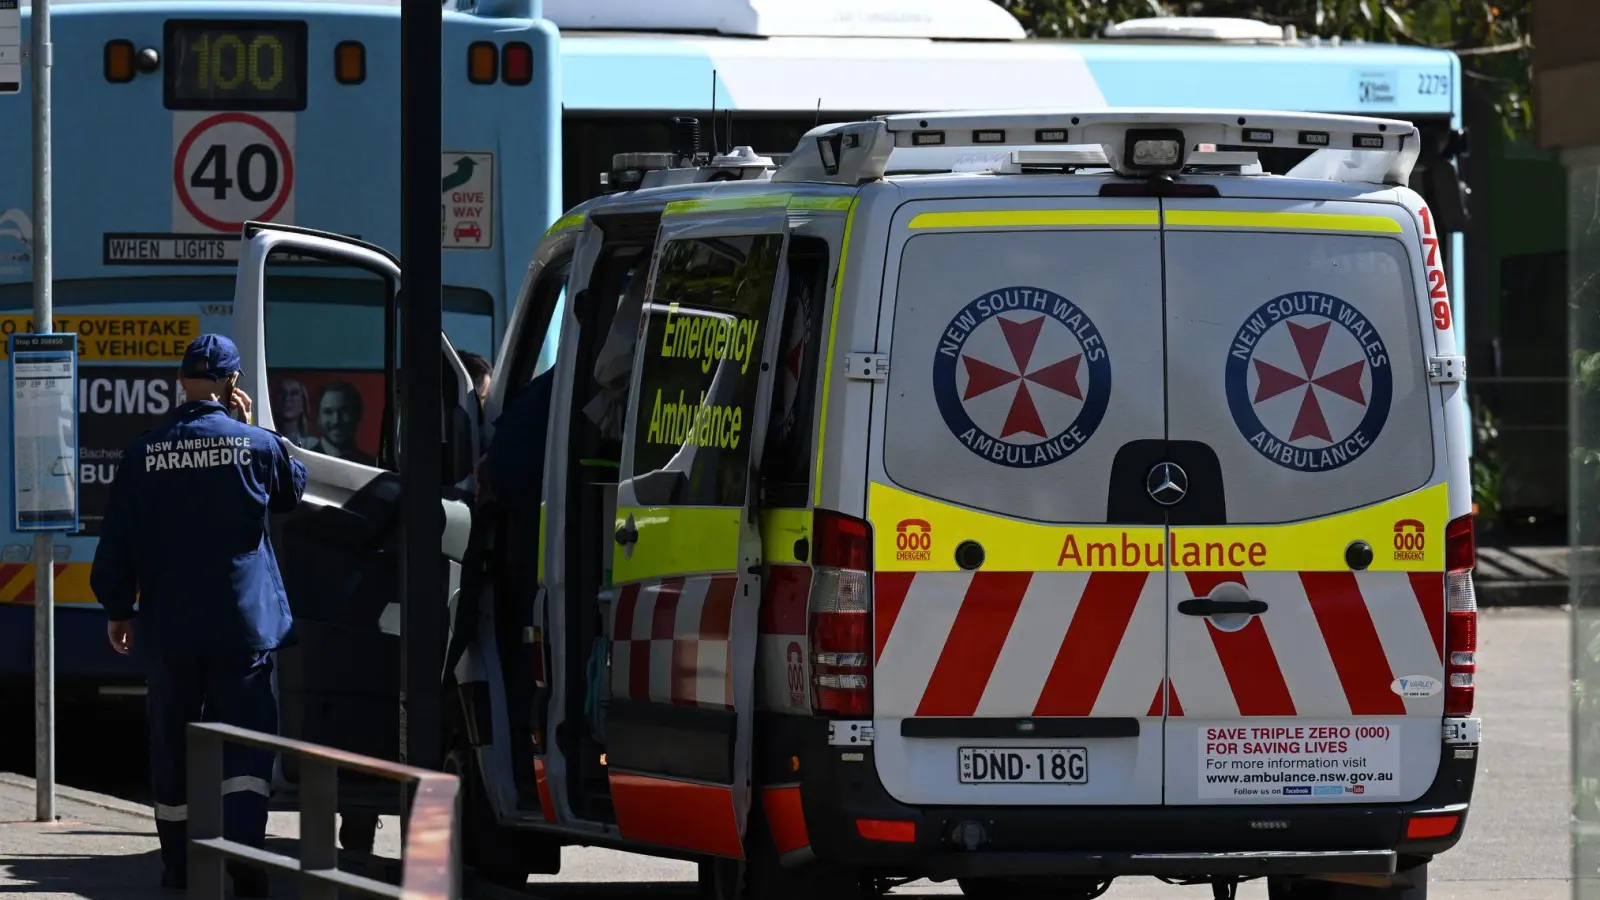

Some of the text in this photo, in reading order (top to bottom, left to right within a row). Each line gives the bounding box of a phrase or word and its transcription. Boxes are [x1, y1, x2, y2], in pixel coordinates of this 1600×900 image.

[192, 34, 283, 91] 100
[1418, 74, 1448, 95] 2279
[190, 143, 278, 202] 40
[452, 192, 484, 203] GIVE
[453, 207, 482, 218] WAY
[109, 241, 225, 259] WHEN LIGHTS
[1418, 207, 1451, 330] 1729
[26, 319, 70, 335] NT
[79, 320, 190, 336] OVERTAKE
[940, 290, 1105, 362] NEW SOUTH WALES
[1232, 295, 1387, 368] NEW SOUTH WALES
[15, 338, 30, 346] Stop
[661, 302, 759, 375] Emergency
[96, 340, 186, 356] VEHICLE
[80, 378, 169, 414] ICMS
[647, 389, 741, 449] Ambulance
[79, 447, 124, 460] Bachelo
[146, 437, 250, 453] NSW AMBULANCE
[960, 425, 1087, 464] AMBULANCE
[1250, 431, 1370, 468] AMBULANCE
[145, 449, 251, 472] PARAMEDIC
[80, 463, 118, 484] BU
[896, 532, 931, 550] 000
[1057, 532, 1267, 566] Ambulance
[1393, 533, 1424, 550] 000
[896, 551, 931, 560] EMERGENCY
[1393, 551, 1424, 561] EMERGENCY
[1207, 726, 1390, 741] SAVE TRIPLE ZERO (000)
[1206, 741, 1348, 754] FOR SAVING LIVES
[1206, 757, 1367, 769] For more information visit
[1206, 772, 1393, 784] www.ambulance.nsw.gov.au
